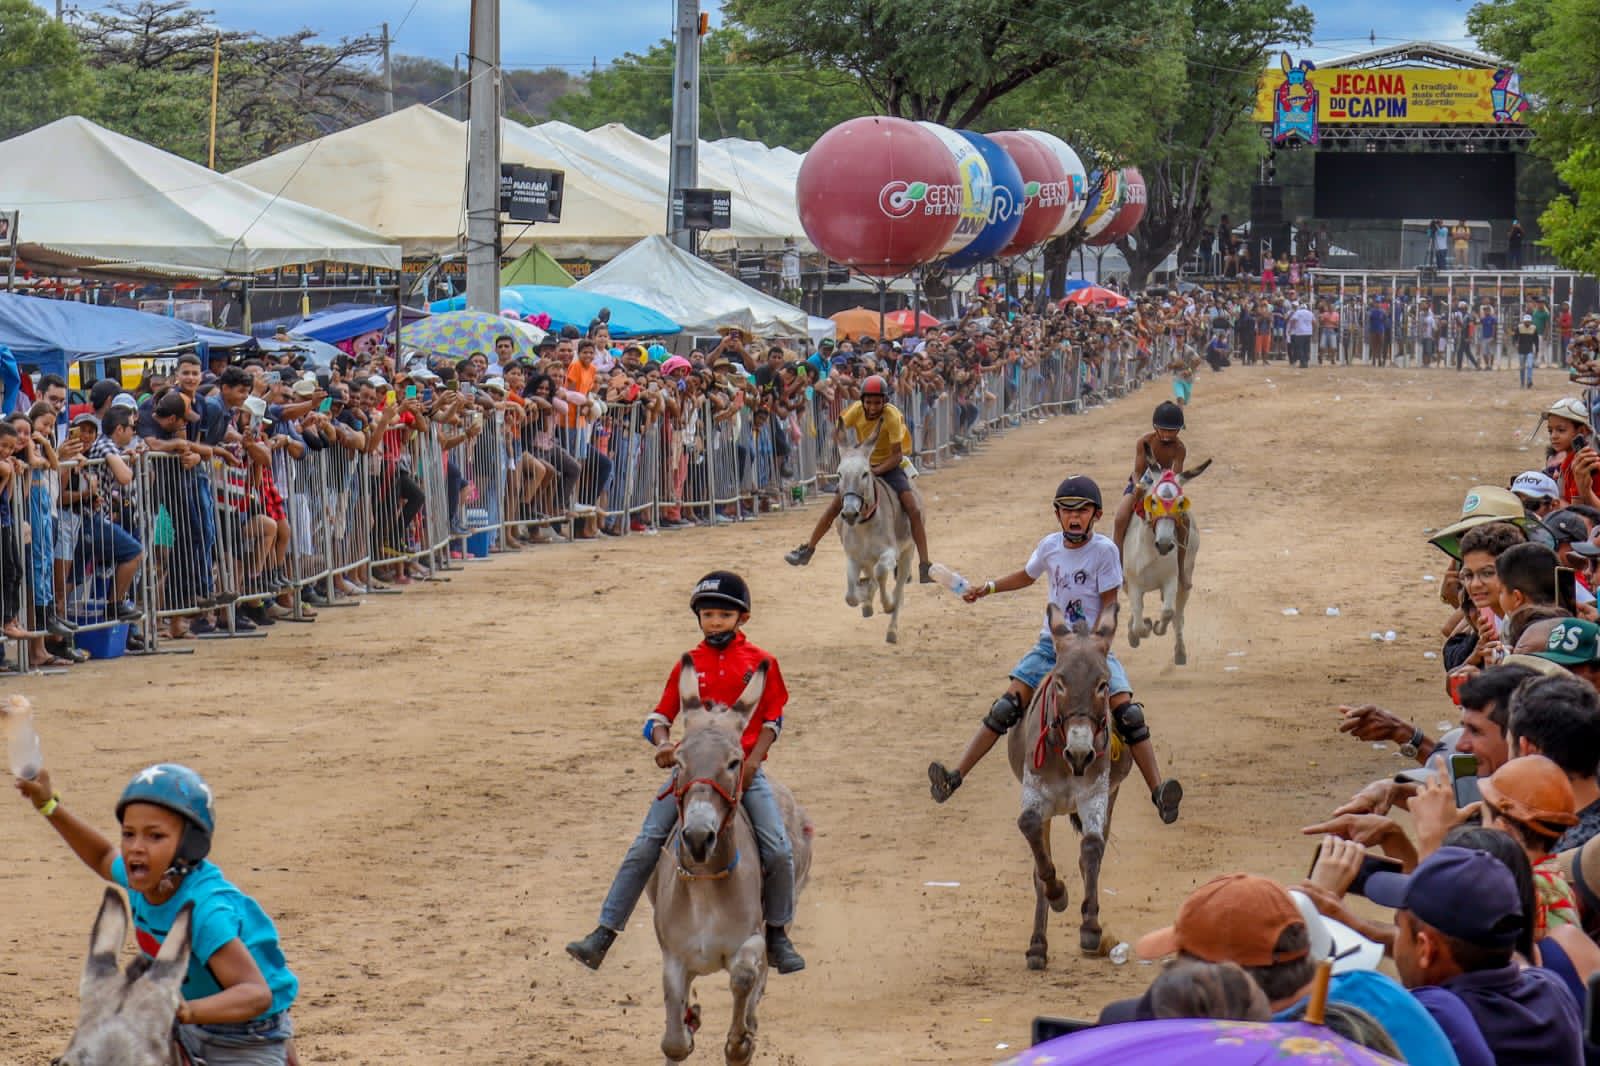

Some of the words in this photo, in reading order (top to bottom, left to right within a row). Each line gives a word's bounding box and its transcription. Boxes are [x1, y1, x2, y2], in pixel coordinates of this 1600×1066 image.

[1329, 74, 1406, 95] JECANA
[1330, 97, 1347, 110] DO
[1348, 97, 1407, 118] CAPIM
